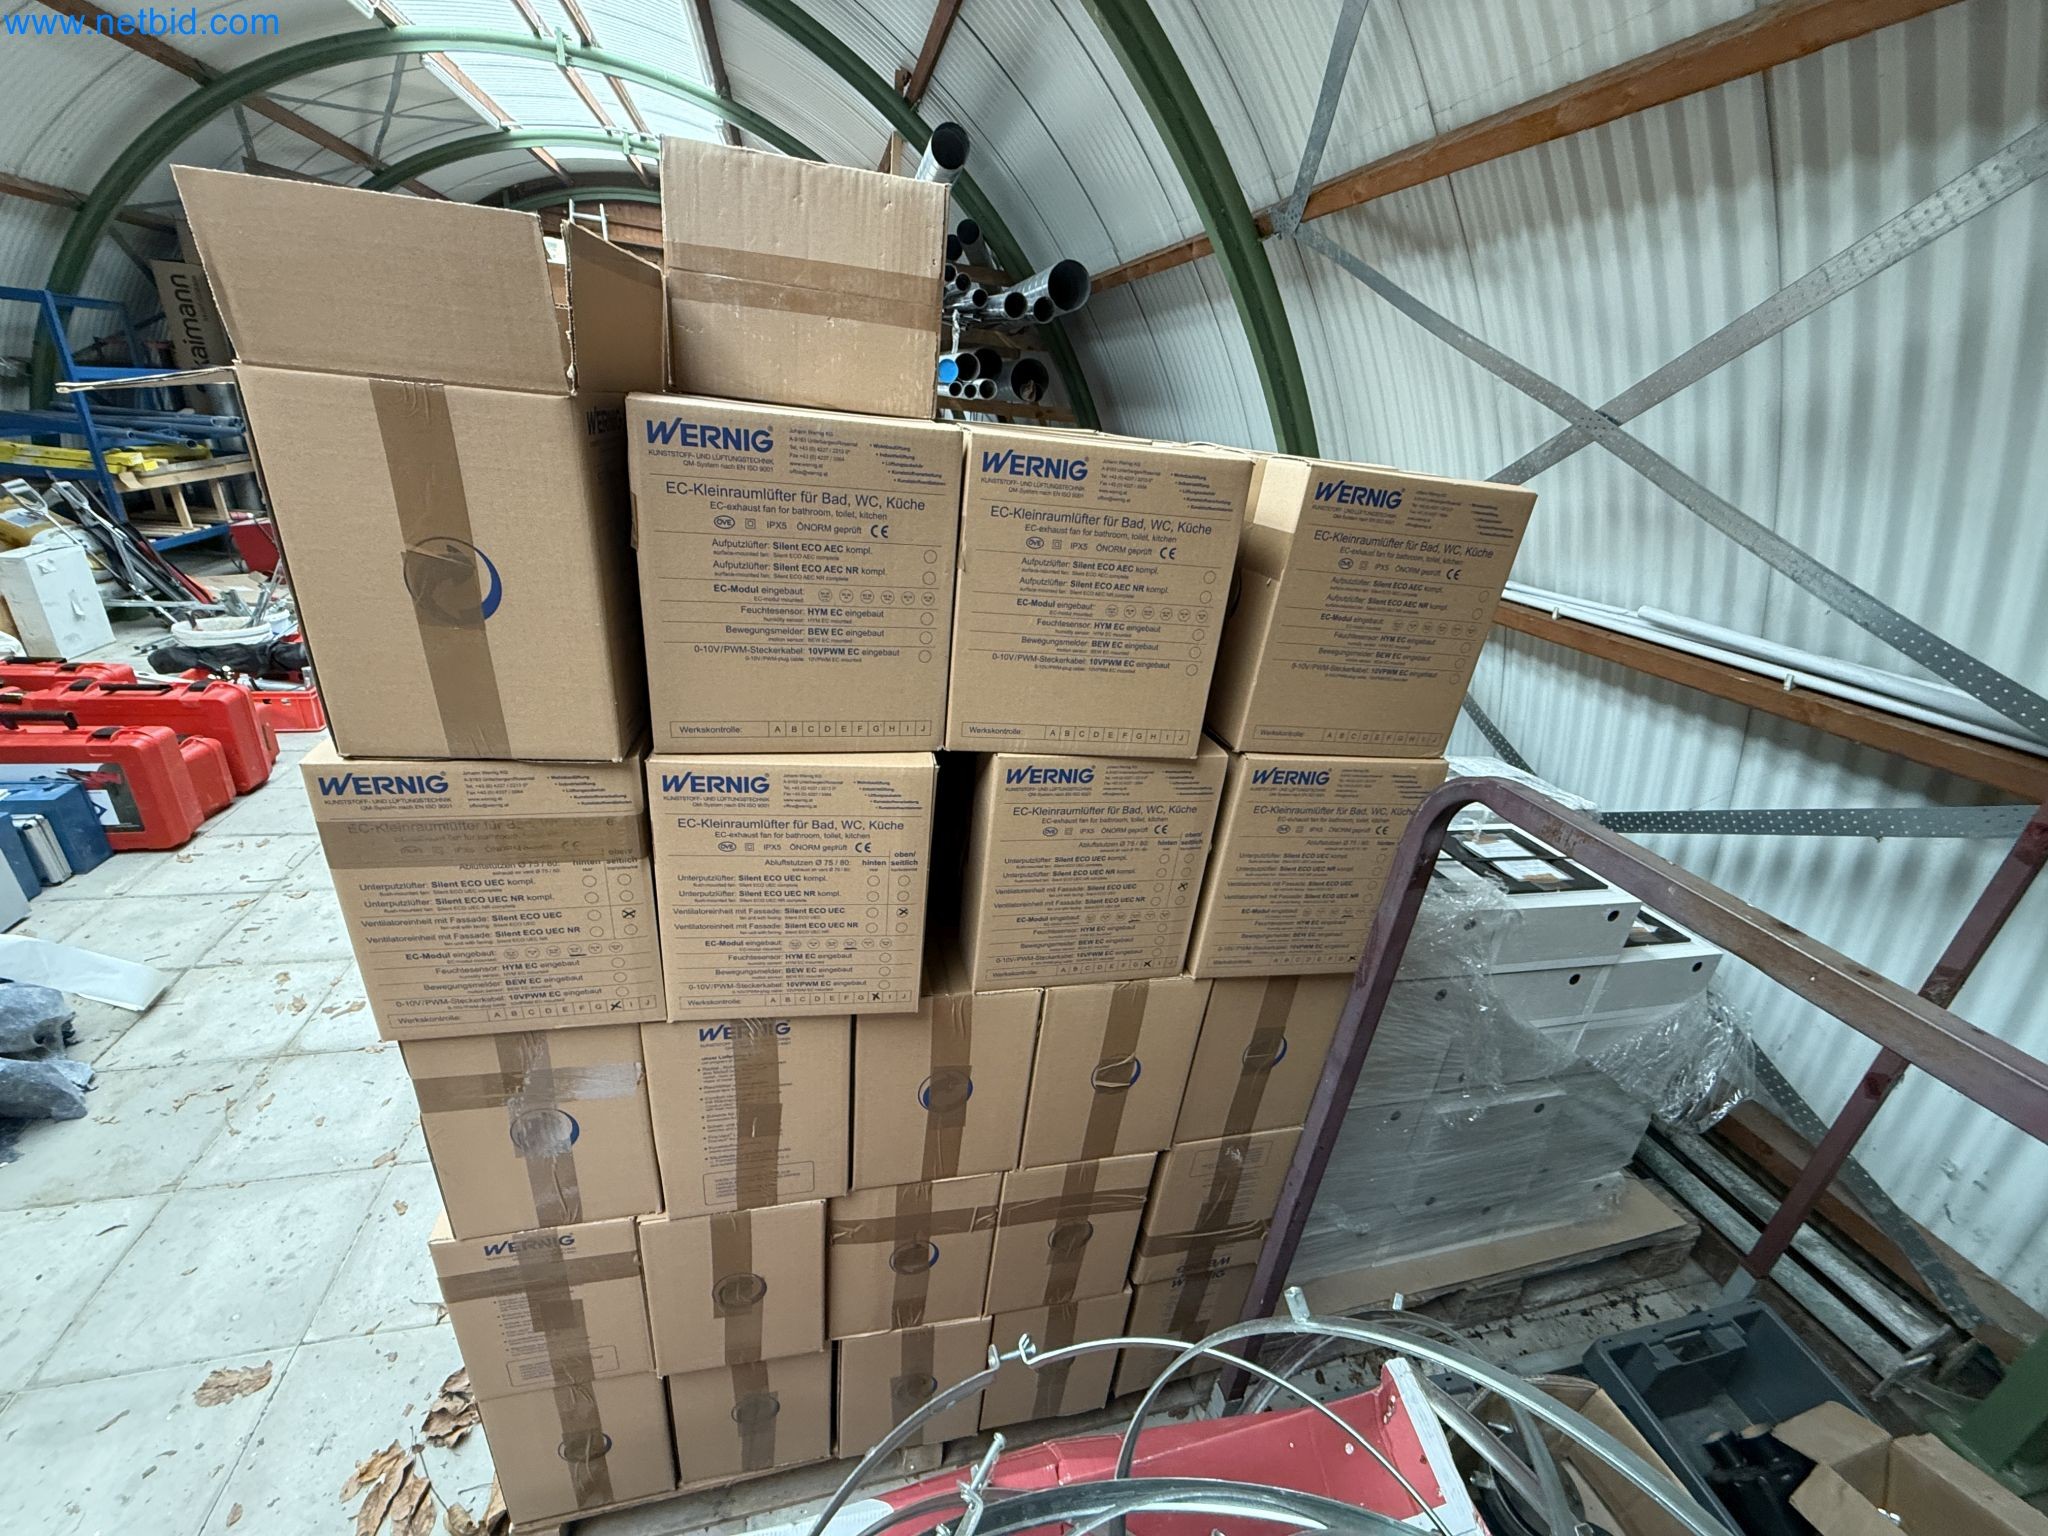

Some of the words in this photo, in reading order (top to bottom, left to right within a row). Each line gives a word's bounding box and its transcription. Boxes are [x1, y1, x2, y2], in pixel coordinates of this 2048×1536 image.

[646, 417, 773, 453] WERNIG
[982, 449, 1088, 481] WERNIG
[666, 481, 796, 502] EC-Kleinraumlüfter
[800, 490, 817, 504] für
[822, 492, 850, 508] Bad,
[855, 495, 882, 510] WC,
[886, 496, 925, 511] Küche
[1315, 480, 1403, 510] WERNIG
[710, 501, 760, 512] EC-exhaust
[762, 505, 776, 513] fan
[778, 506, 790, 514] for
[792, 506, 833, 518] bathroom,
[835, 509, 857, 519] toilet,
[859, 511, 887, 520] kitchen
[766, 521, 787, 530] IPX5
[796, 521, 831, 532] ÖNORM
[833, 524, 861, 536] geprüft
[991, 505, 1100, 525] EC-Kleinraumlüfter
[1103, 514, 1119, 527] für
[1120, 517, 1146, 531] Bad,
[1149, 519, 1174, 533] WC,
[1176, 521, 1211, 535] Küche
[711, 538, 770, 550] Aufputzlüfter:
[772, 541, 799, 551] Silent
[801, 543, 822, 552] ECO
[824, 544, 843, 553] AEC
[846, 545, 872, 556] kompl.
[1070, 542, 1088, 550] IPX5
[1096, 542, 1127, 553] ÖNORM
[1127, 546, 1152, 557] geprüft
[1314, 530, 1404, 549] EC-Kleinraumlüfter
[1404, 539, 1419, 551] für
[1418, 541, 1441, 554] Bad,
[1441, 544, 1463, 557] WC,
[1463, 546, 1493, 558] Küche
[713, 560, 770, 571] Aufputzlüfter:
[773, 562, 799, 572] Silent
[801, 564, 822, 573] ECO
[824, 565, 843, 573] AEC
[845, 566, 858, 574] NR
[861, 566, 887, 577] kompl.
[1022, 556, 1071, 568] Aufputzlüfter:
[1073, 560, 1096, 569] Silent
[1097, 562, 1115, 571] ECO
[1116, 564, 1134, 572] AEC
[1135, 565, 1159, 575] kompl.
[714, 584, 758, 593] EC-Modul
[1020, 576, 1069, 588] Aufputzlüfter:
[1070, 579, 1093, 588] Silent
[1094, 581, 1113, 590] ECO
[1113, 583, 1131, 591] AEC
[1132, 584, 1144, 592] NR
[1145, 585, 1169, 595] kompl.
[1017, 598, 1055, 607] EC-Modul
[741, 606, 804, 615] Feuchtesensor:
[807, 608, 828, 616] HYM
[845, 609, 883, 619] eingebaut
[725, 625, 804, 637] Bewegungsmelder:
[831, 628, 843, 636] EC
[845, 629, 884, 638] eingebaut
[1037, 618, 1092, 628] Feuchtesensor:
[1126, 624, 1161, 634] eingebaut
[694, 645, 805, 655] 0-10V/PWM-Steckerkabel:
[808, 647, 845, 655] 10VPWM
[861, 648, 899, 657] eingebaut
[1022, 635, 1090, 648] Bewegungsmelder:
[1124, 642, 1158, 652] eingebaut
[661, 771, 769, 794] WERNIG
[1006, 765, 1095, 784] WERNIG
[1252, 767, 1330, 785] WERNIG
[317, 771, 451, 796] WERNIG
[1013, 806, 1105, 816] EC-Kleinraumlüfter
[1107, 806, 1120, 814] für
[1122, 806, 1143, 815] Bad,
[1145, 806, 1166, 815] WC,
[1168, 805, 1197, 813] Küche
[678, 818, 789, 829] EC-Kleinraumlüfter
[793, 819, 808, 829] für
[812, 820, 837, 830] Bad,
[841, 820, 865, 831] WC,
[869, 820, 903, 829] Küche
[358, 882, 428, 892] Unterputzlüfter:
[430, 880, 459, 888] Silent
[507, 877, 536, 886] kompl.
[363, 898, 432, 909] Unterputzlüfter:
[434, 897, 463, 905] Silent
[526, 893, 555, 902] kompl.
[360, 918, 432, 928] Ventilatoreinheit
[449, 915, 489, 923] Fassade:
